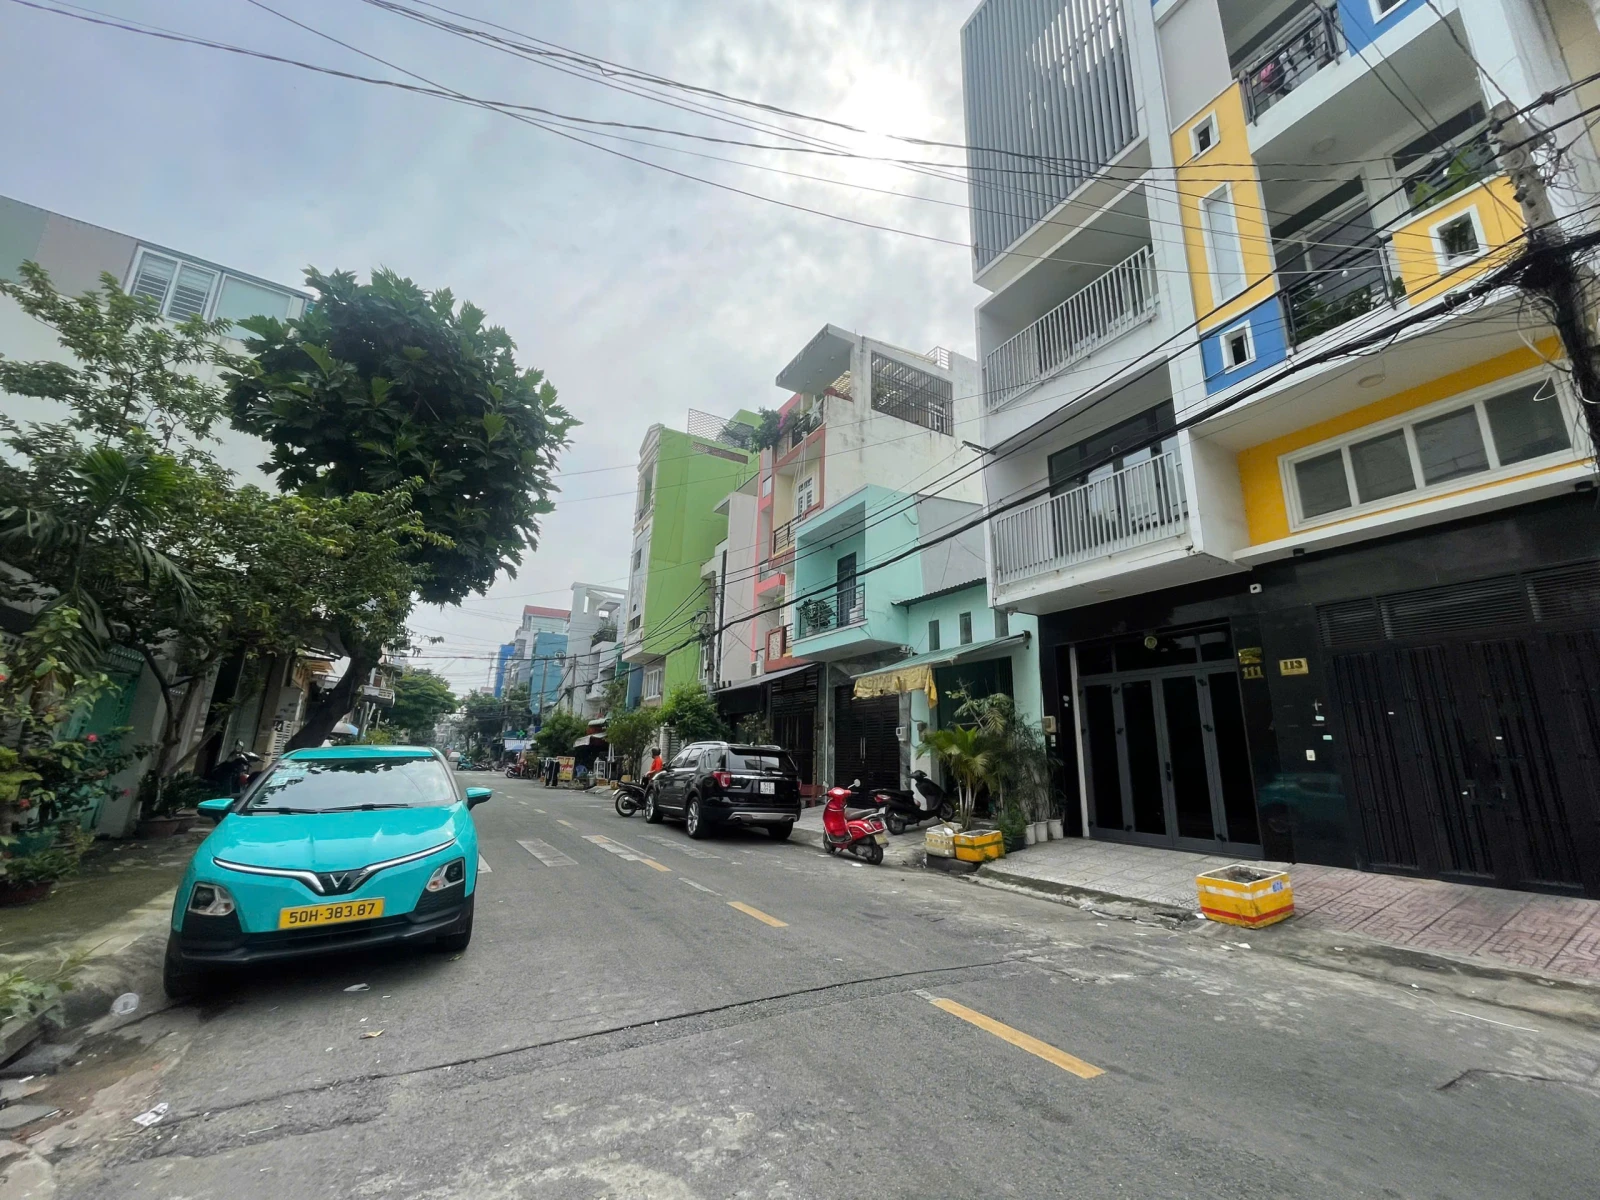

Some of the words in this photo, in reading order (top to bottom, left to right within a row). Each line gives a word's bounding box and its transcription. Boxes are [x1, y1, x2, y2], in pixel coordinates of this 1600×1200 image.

[1283, 660, 1303, 670] 113
[1242, 666, 1264, 679] 111
[288, 903, 375, 924] 50H-383.87
